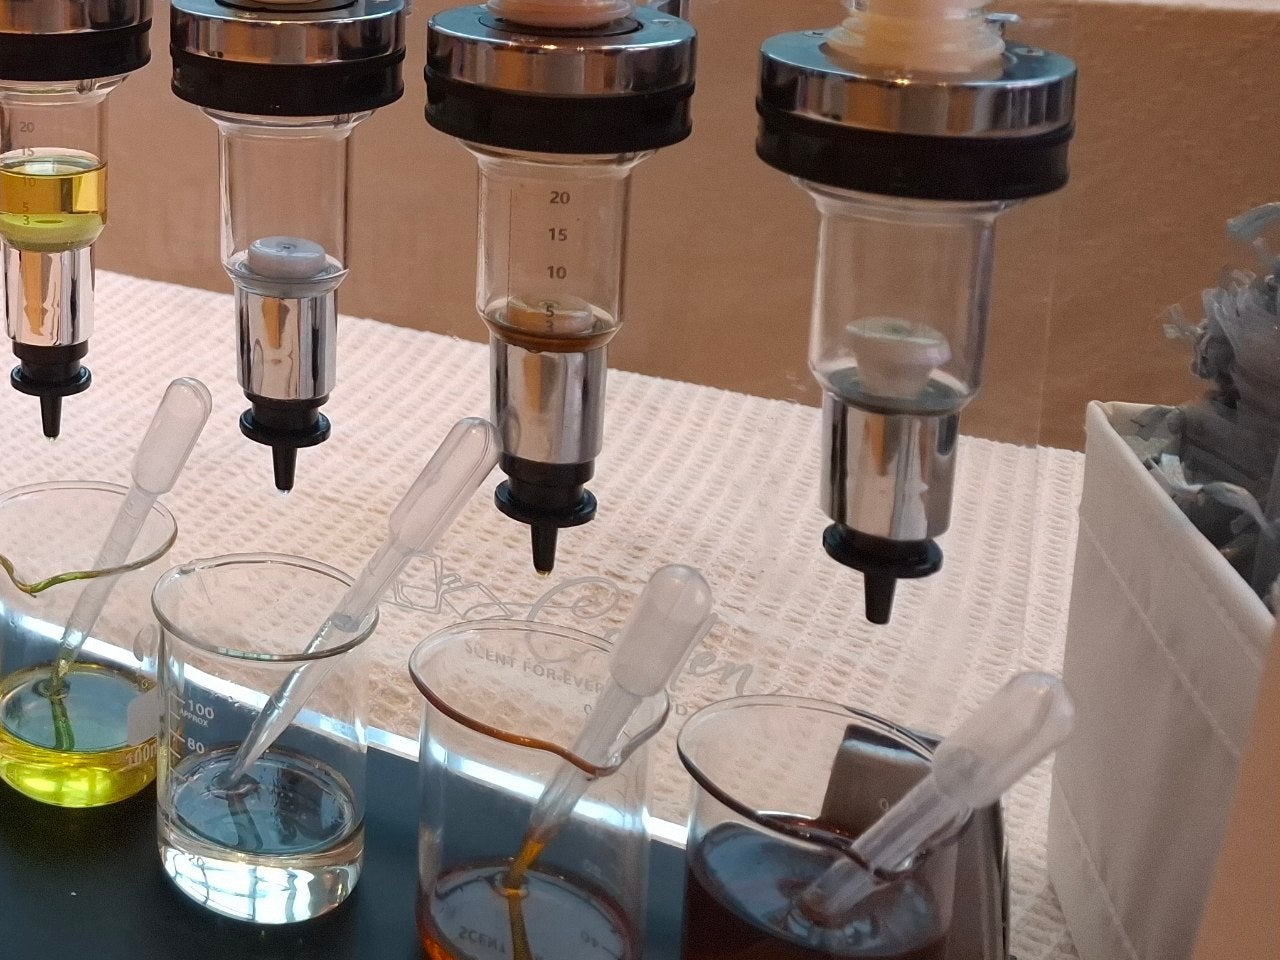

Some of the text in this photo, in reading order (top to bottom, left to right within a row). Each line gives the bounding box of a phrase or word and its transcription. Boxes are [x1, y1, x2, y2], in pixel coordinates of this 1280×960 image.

[20, 122, 35, 133] 20
[21, 146, 35, 157] 15
[549, 191, 571, 205] 20
[549, 227, 568, 242] 15
[547, 266, 567, 280] 10
[545, 305, 555, 318] 5
[186, 701, 215, 721] 100
[180, 709, 210, 728] APPROX
[187, 737, 206, 755] 80
